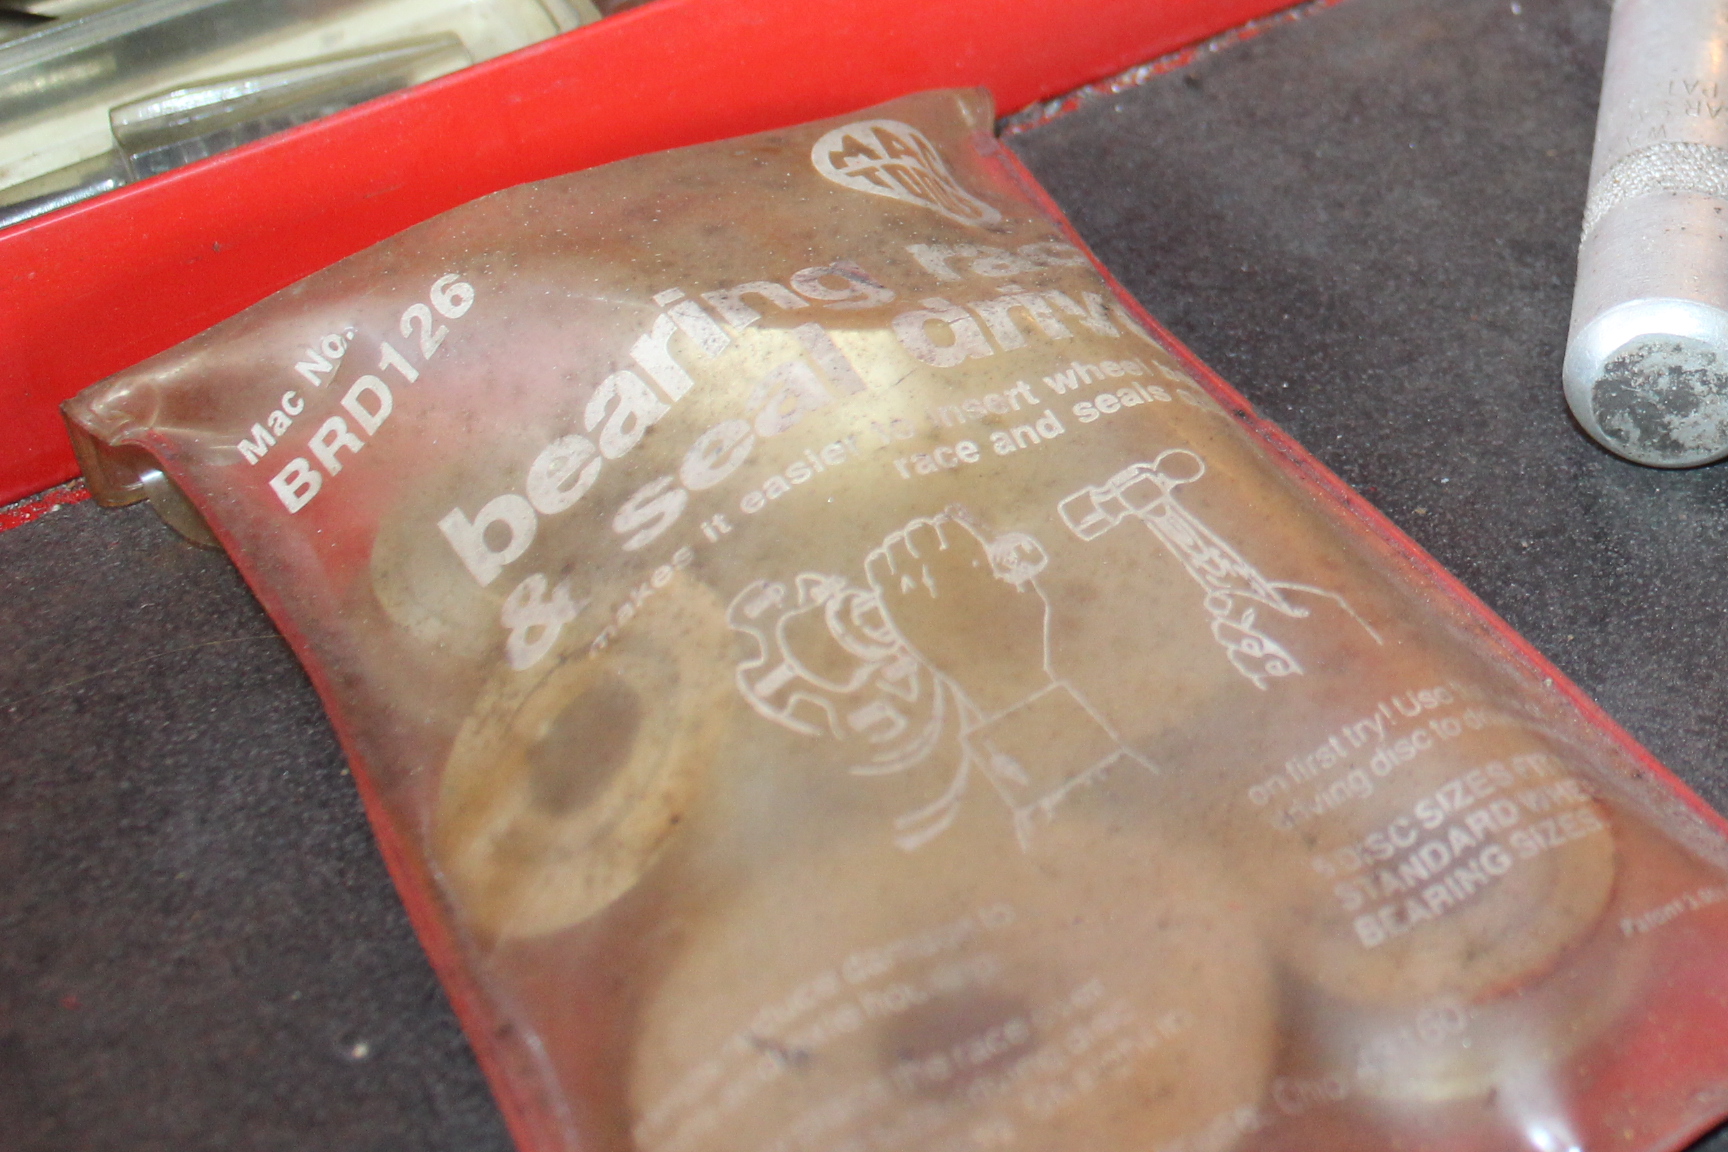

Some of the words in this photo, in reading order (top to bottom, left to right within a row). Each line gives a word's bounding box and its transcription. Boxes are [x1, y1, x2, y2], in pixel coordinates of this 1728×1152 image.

[236, 390, 305, 466] Mac
[294, 329, 355, 387] No.
[269, 273, 475, 515] BRD126
[438, 259, 896, 587] bearing
[893, 439, 980, 480] race
[989, 409, 1066, 456] and
[1072, 381, 1173, 424] seals
[501, 573, 591, 672] &
[612, 321, 867, 552] seal
[700, 513, 733, 543] it
[740, 433, 860, 515] easier
[1247, 774, 1289, 807] on
[1284, 734, 1349, 785] first
[1341, 700, 1399, 751] try!
[1369, 727, 1435, 778] disc
[1413, 759, 1515, 831] SIZES
[1334, 797, 1521, 912] STANDARD
[1353, 845, 1514, 949] BEARING
